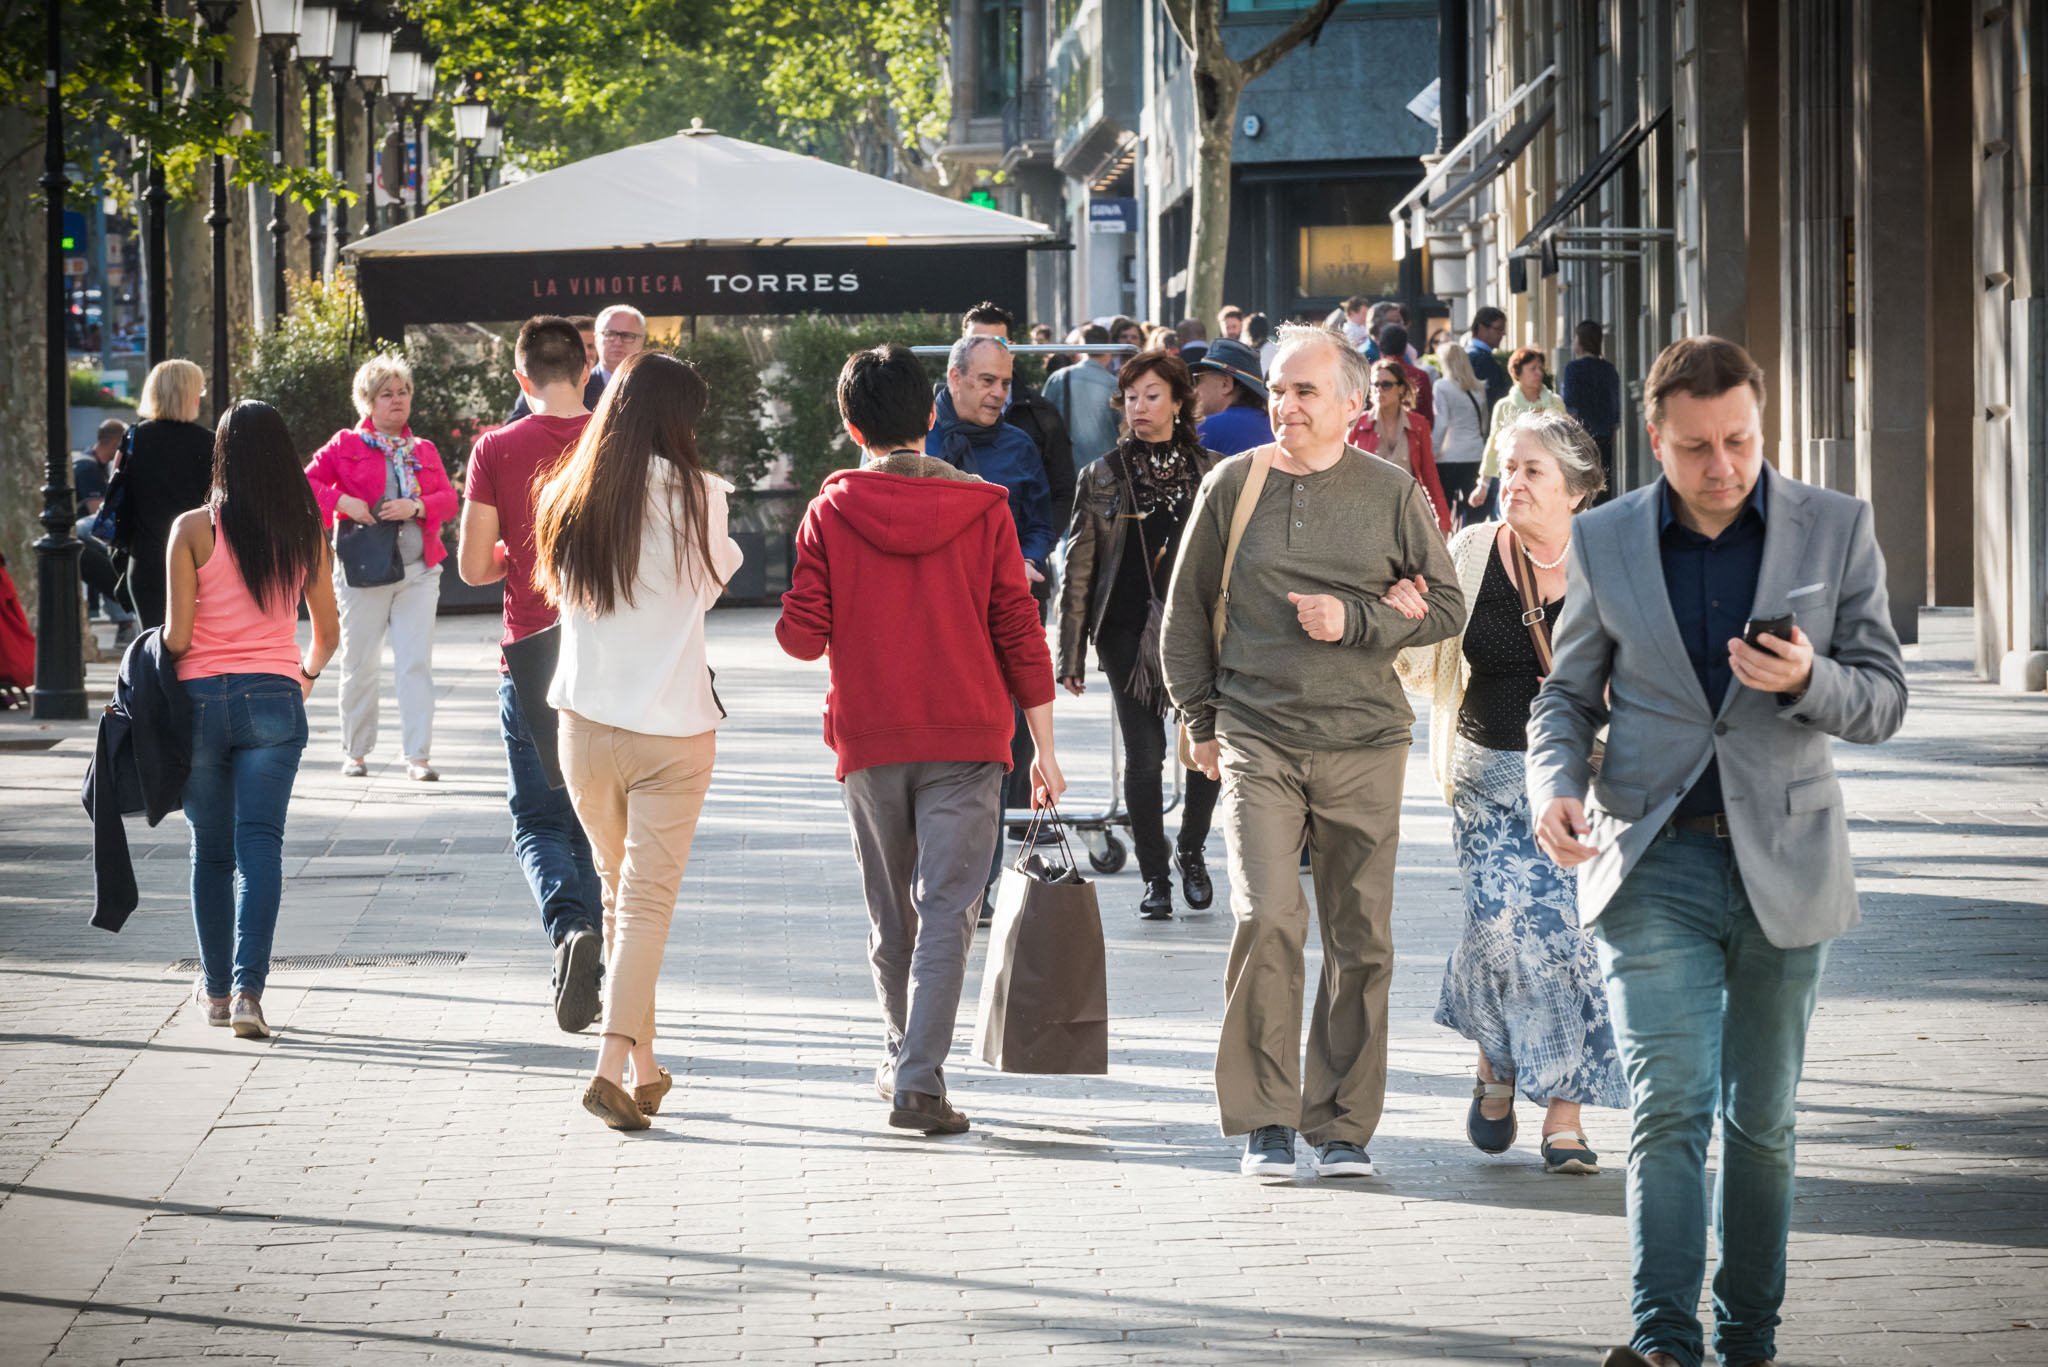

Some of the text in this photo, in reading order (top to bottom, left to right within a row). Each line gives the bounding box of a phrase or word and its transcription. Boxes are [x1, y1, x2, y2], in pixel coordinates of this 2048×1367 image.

[533, 273, 860, 297] LA VINOTECA TORRES
